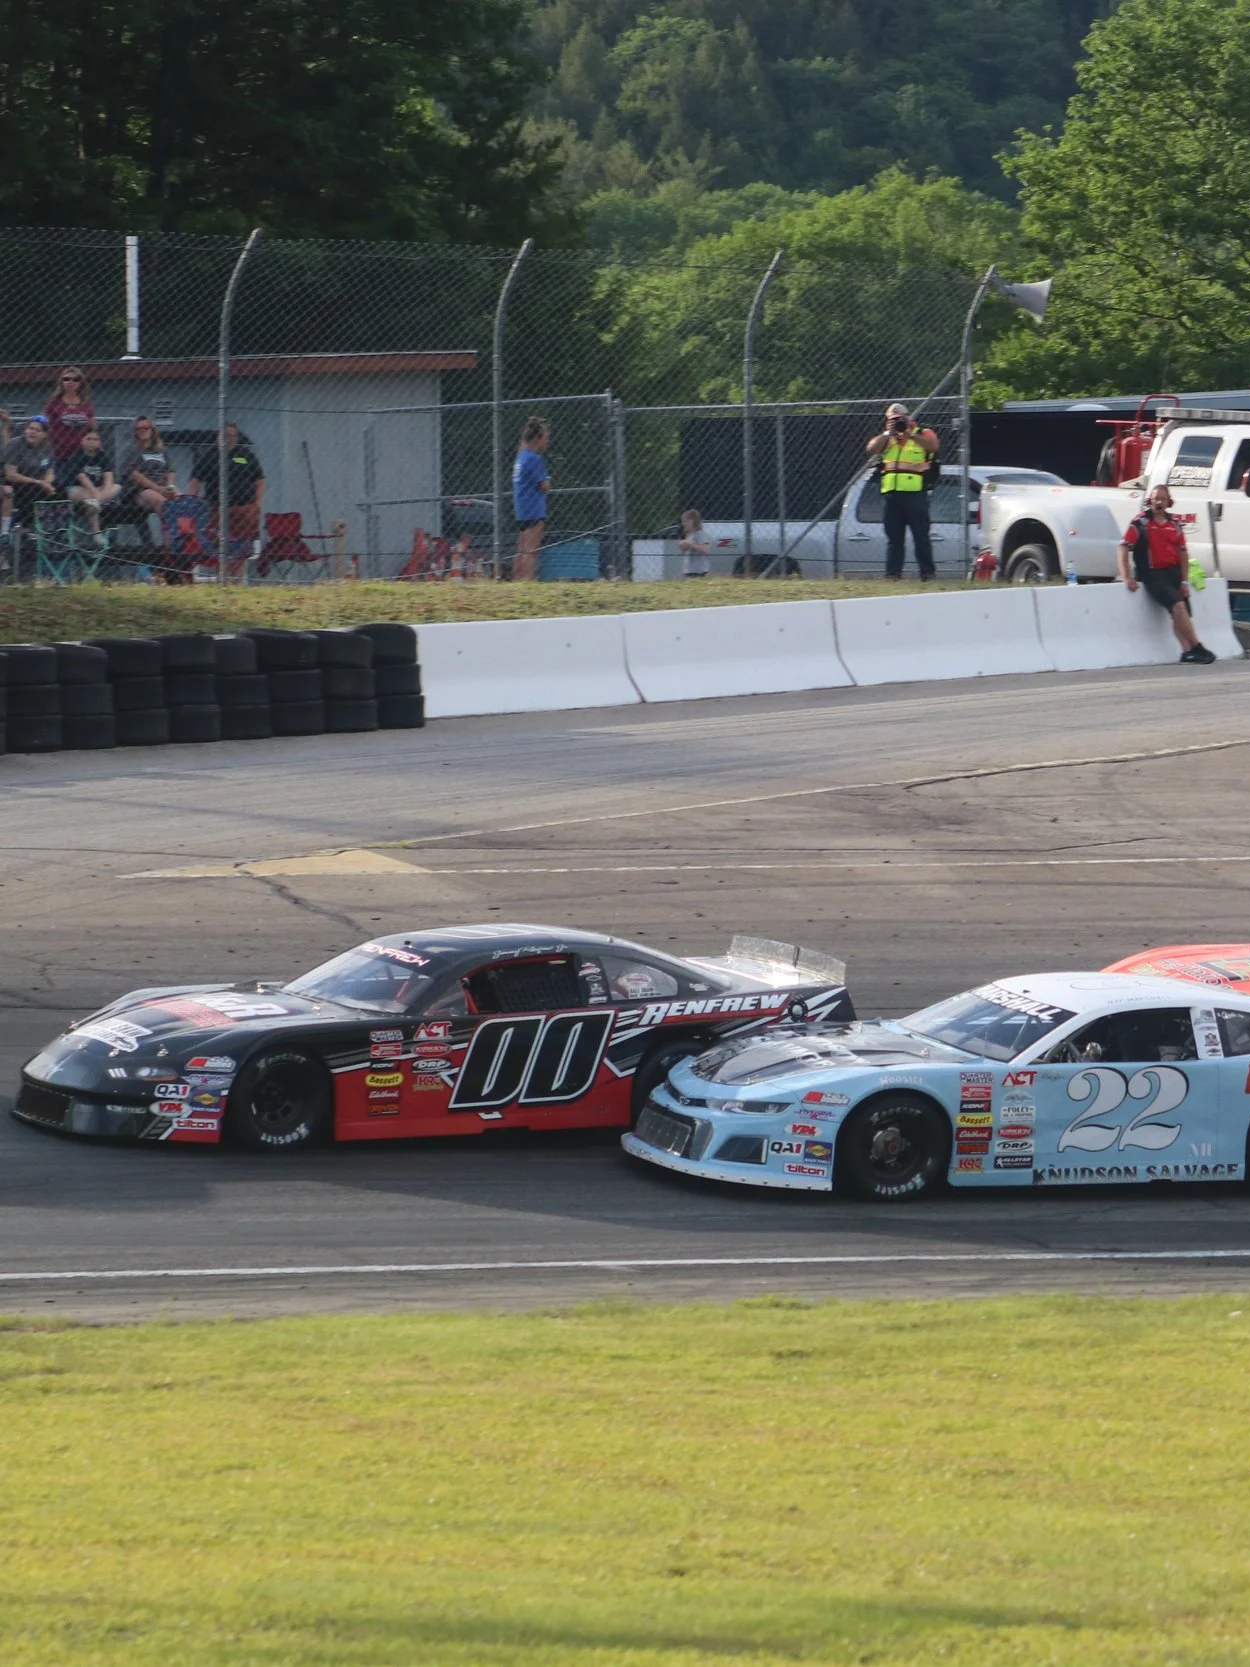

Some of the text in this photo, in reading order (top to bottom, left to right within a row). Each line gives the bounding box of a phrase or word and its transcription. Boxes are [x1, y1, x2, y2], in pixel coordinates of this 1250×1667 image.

[638, 993, 790, 1025] RENFREW
[971, 983, 1064, 1021] MARSHALL
[448, 1010, 617, 1110] 00
[156, 1085, 189, 1096] QA1
[1057, 1064, 1189, 1153] 22
[175, 1119, 215, 1129] tilton
[960, 1115, 991, 1125] Bassett
[1002, 1142, 1029, 1150] DRP
[786, 1163, 826, 1176] tilton
[1146, 1162, 1239, 1181] SALVAGE
